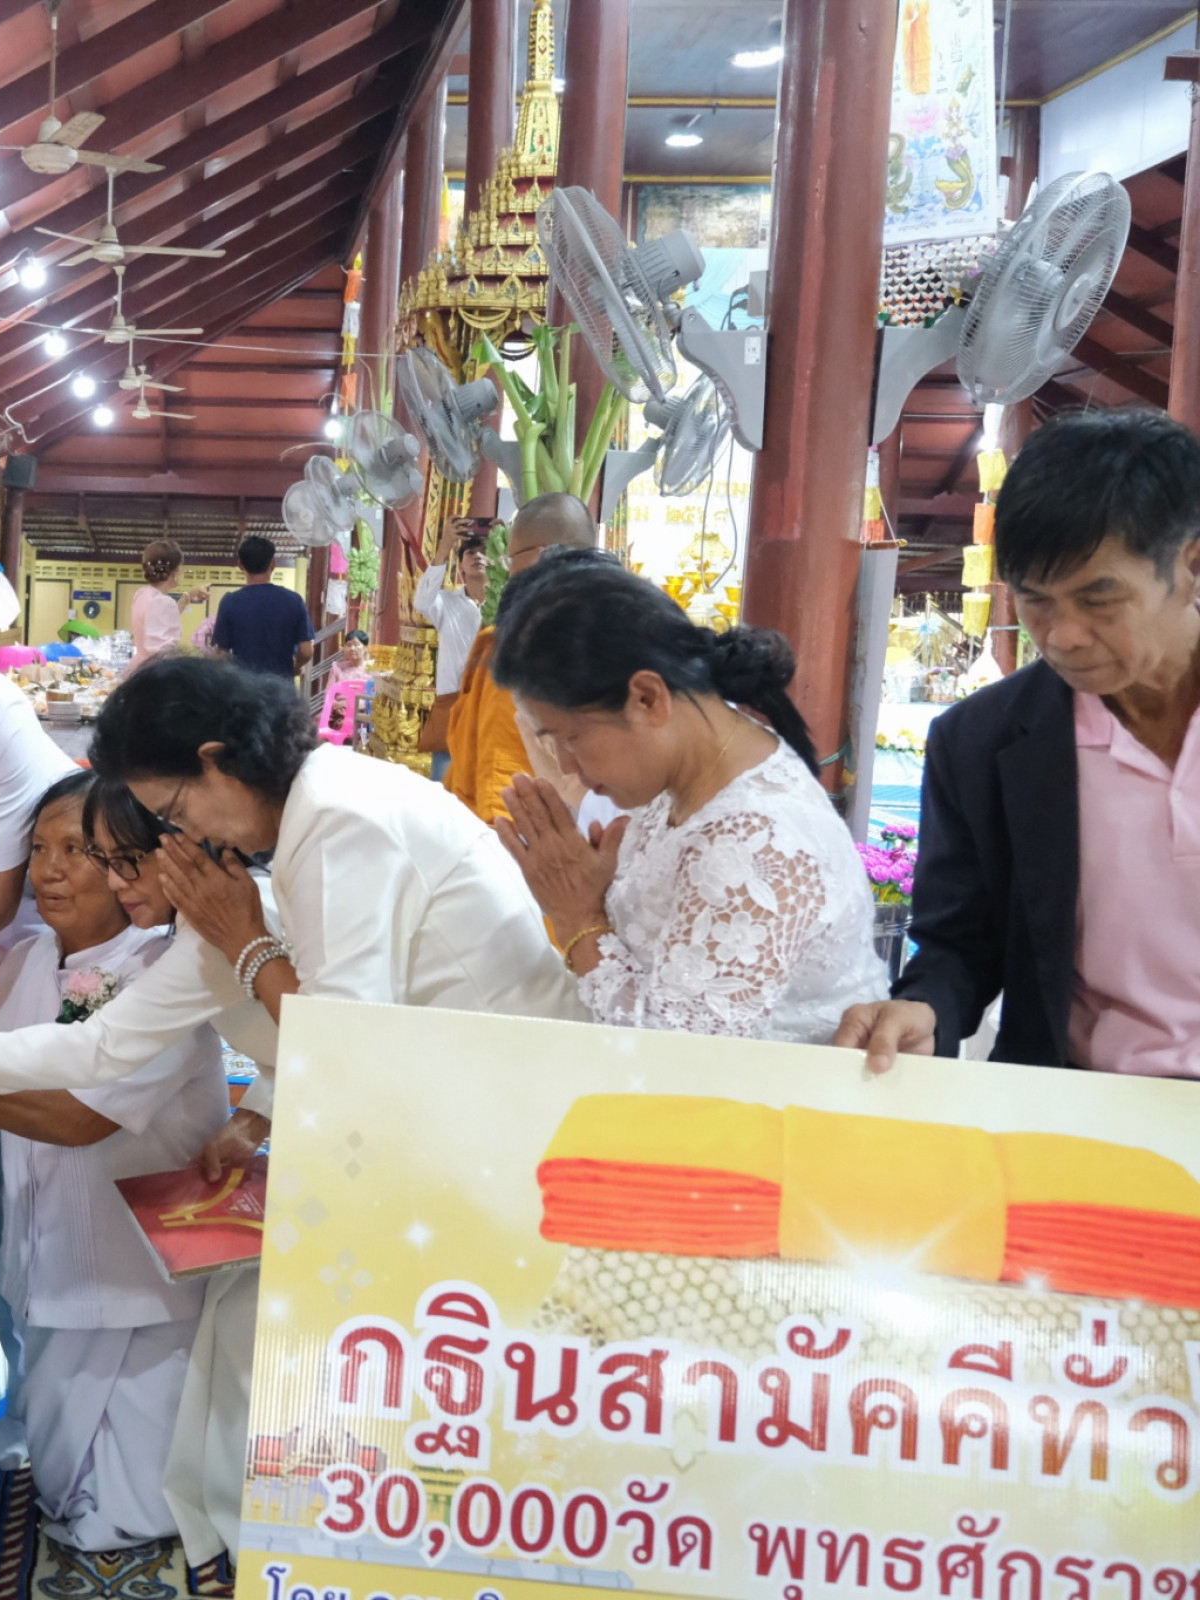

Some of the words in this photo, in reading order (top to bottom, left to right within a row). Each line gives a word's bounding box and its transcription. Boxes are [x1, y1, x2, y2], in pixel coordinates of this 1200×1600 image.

[339, 1291, 1200, 1491] กฐินสามัคคีทั่ว
